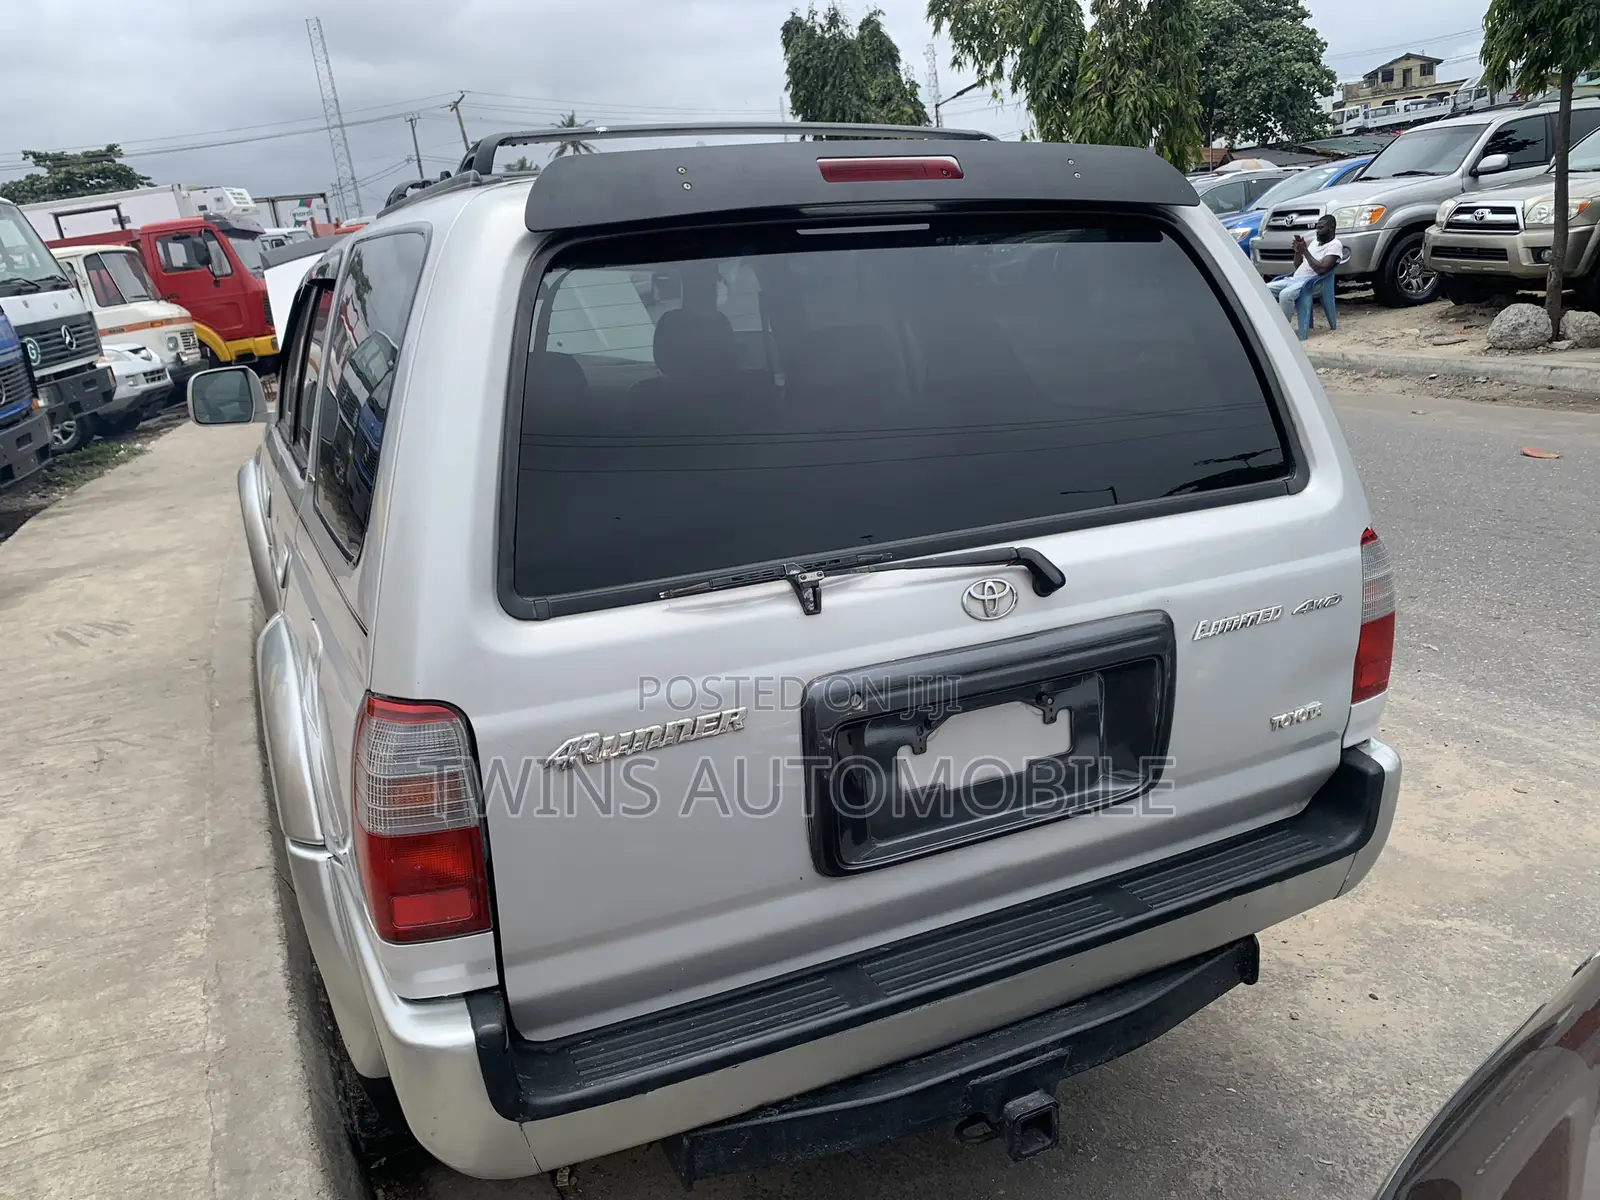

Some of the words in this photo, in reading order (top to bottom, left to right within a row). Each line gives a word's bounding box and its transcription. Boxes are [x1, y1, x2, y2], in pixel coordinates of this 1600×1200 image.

[1192, 604, 1284, 641] LIMITED
[1291, 593, 1343, 616] 4WD
[1270, 701, 1323, 732] TOYOTA
